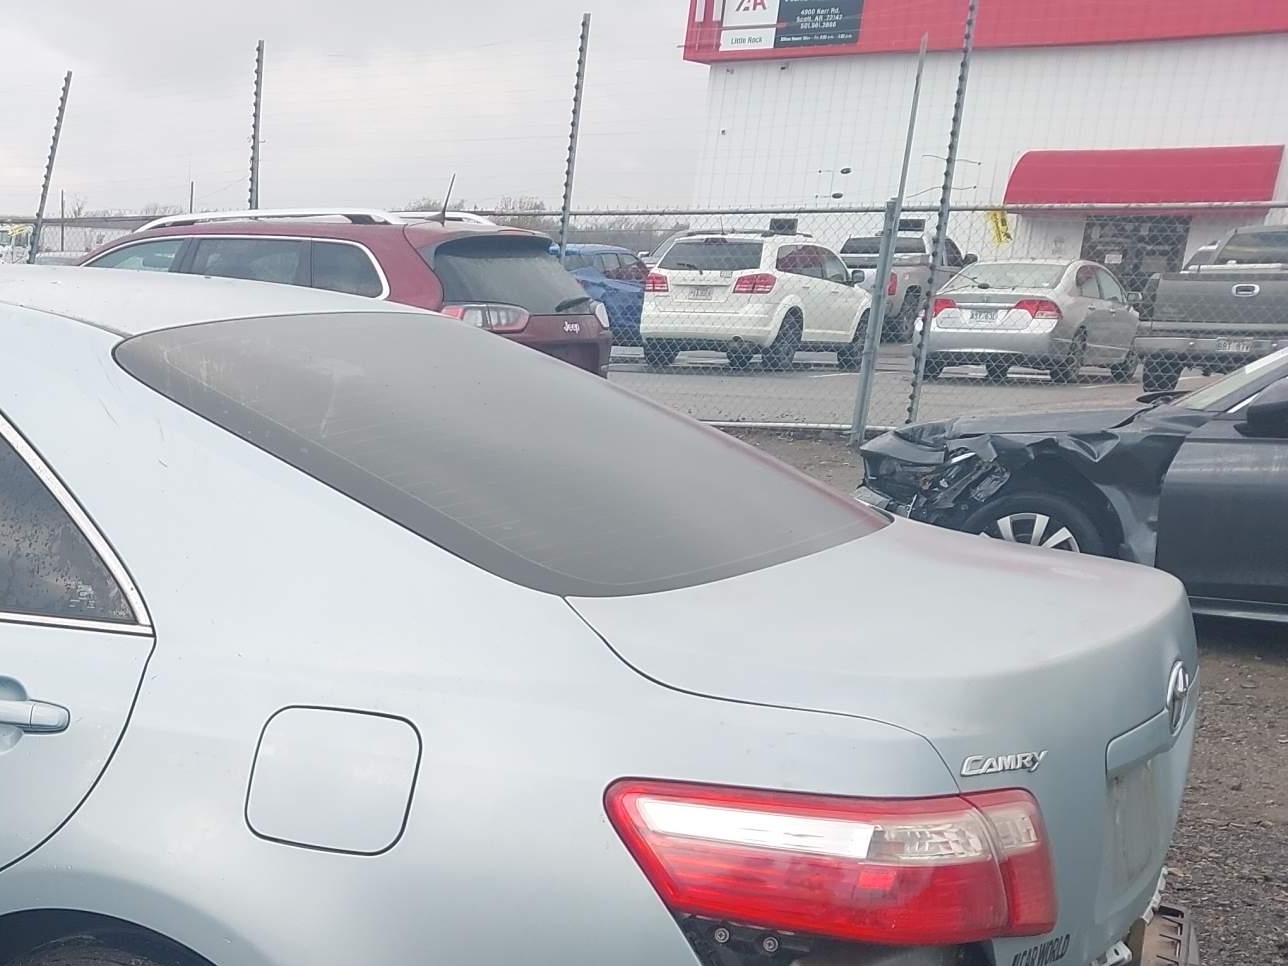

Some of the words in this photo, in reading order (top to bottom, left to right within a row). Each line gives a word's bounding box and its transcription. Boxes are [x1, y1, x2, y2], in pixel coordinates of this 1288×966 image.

[731, 37, 746, 45] Little
[747, 36, 762, 44] Rock
[563, 320, 580, 334] Jeep
